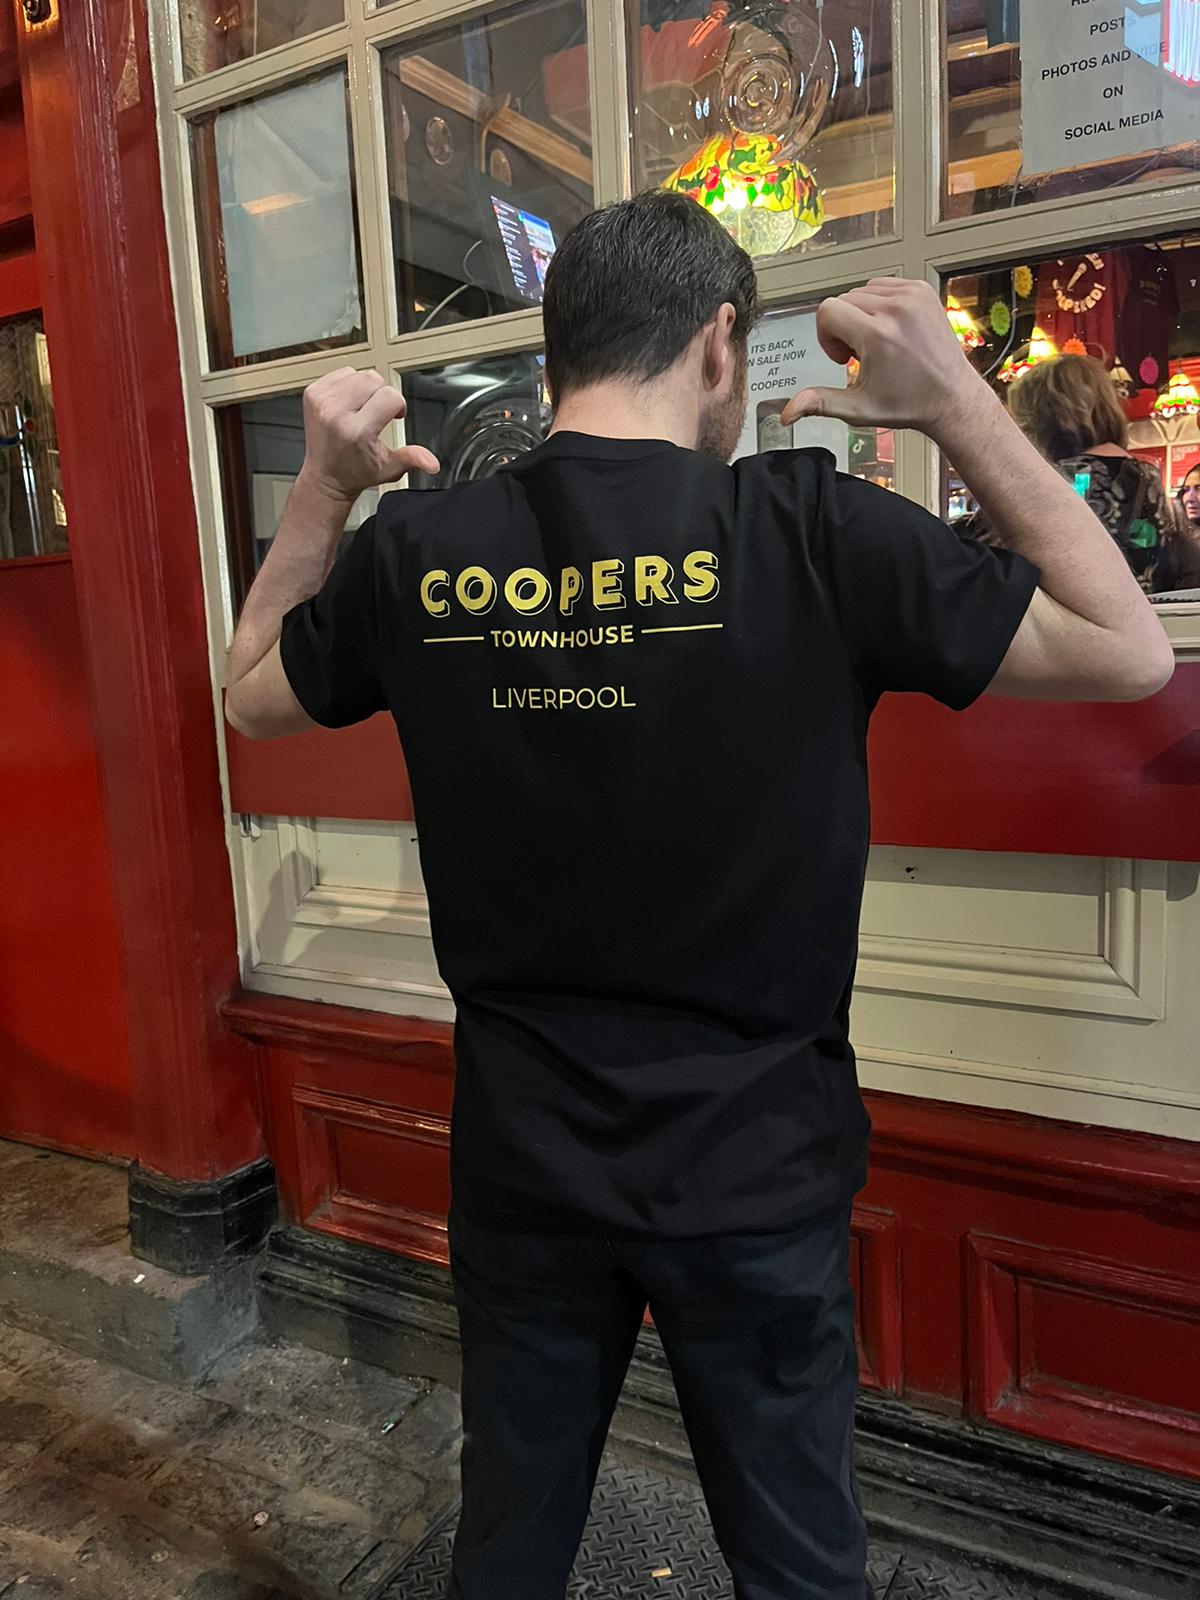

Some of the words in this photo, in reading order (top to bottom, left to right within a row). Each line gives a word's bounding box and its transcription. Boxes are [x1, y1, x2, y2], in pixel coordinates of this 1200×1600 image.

[1089, 16, 1136, 35] POSTS
[1041, 57, 1098, 80] PHOTOS
[1101, 49, 1131, 66] AND
[1103, 85, 1124, 99] ON
[1064, 120, 1115, 140] SOCIAL
[1119, 109, 1164, 128] MEDIA
[751, 344, 766, 354] ITS
[768, 339, 794, 351] BACK
[747, 358, 755, 367] N
[756, 354, 781, 366] SALE
[783, 349, 806, 361] NOW
[768, 367, 779, 376] AT
[750, 377, 797, 391] COOPERS
[420, 550, 720, 617] COOPERS
[490, 624, 634, 648] TOWNHOUSE
[492, 686, 636, 709] LIVERPOOL
